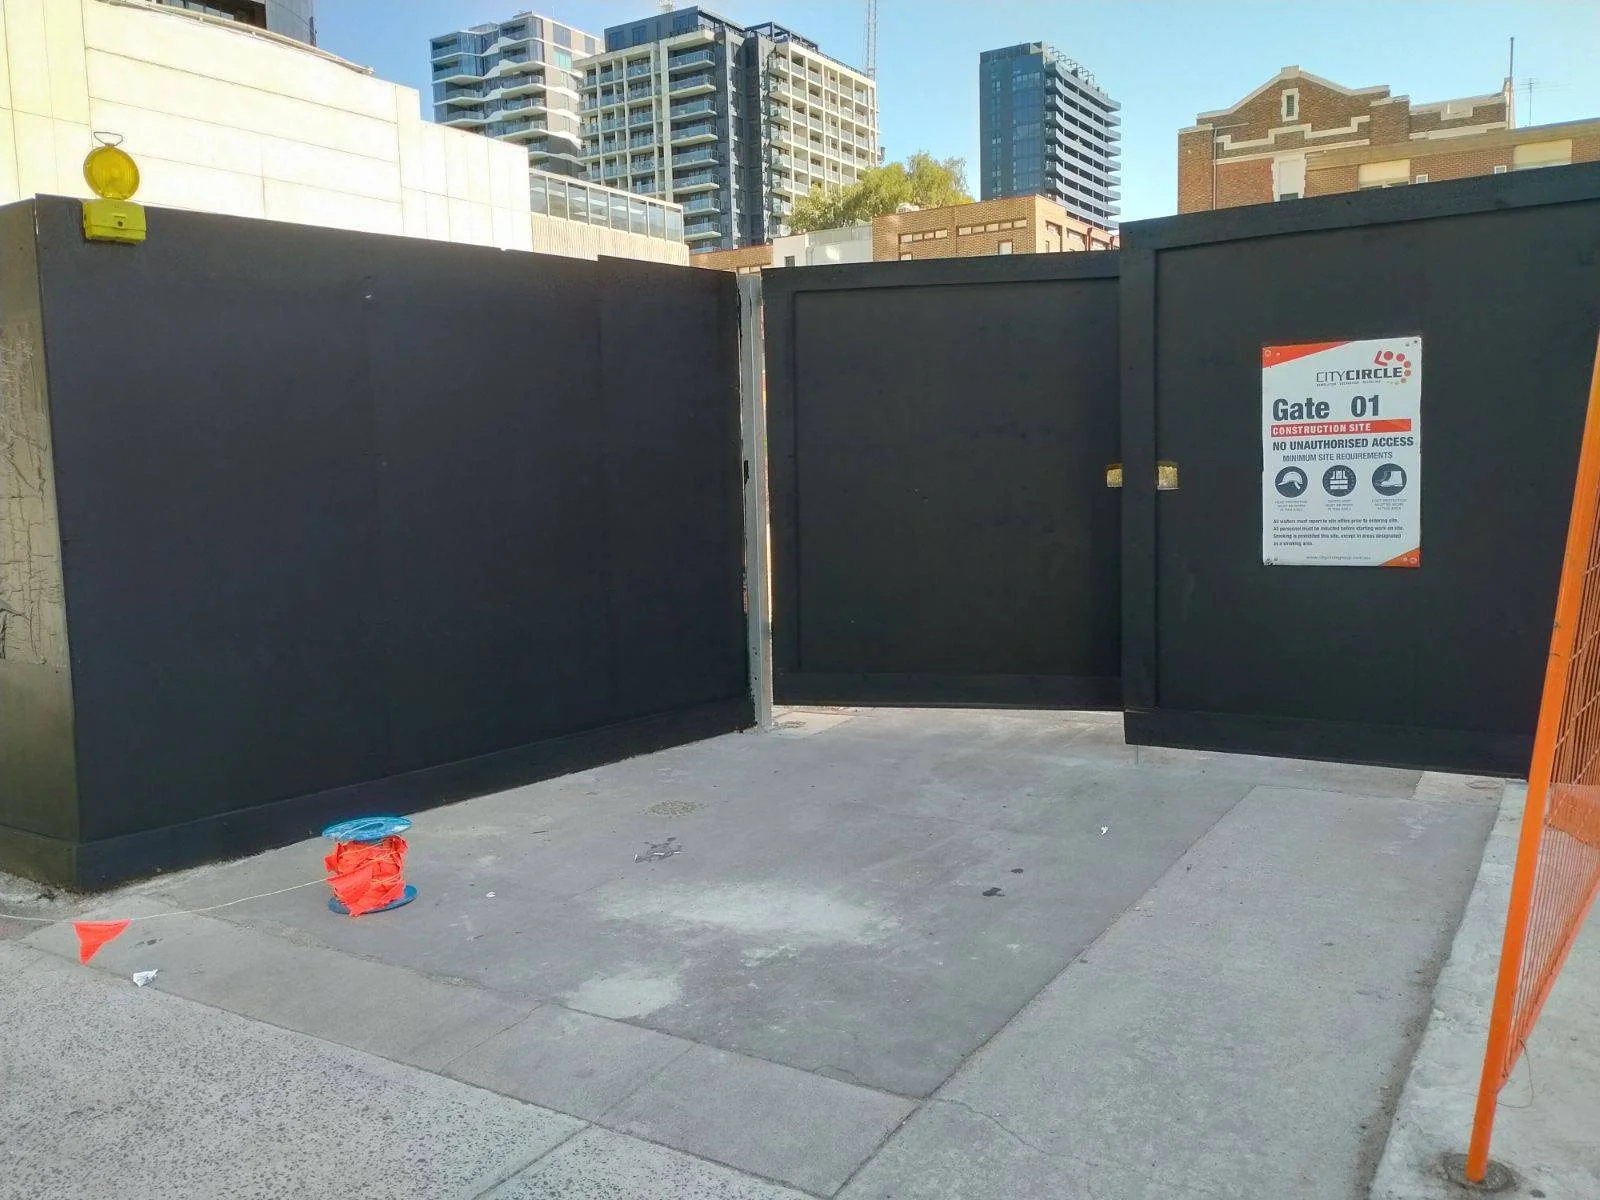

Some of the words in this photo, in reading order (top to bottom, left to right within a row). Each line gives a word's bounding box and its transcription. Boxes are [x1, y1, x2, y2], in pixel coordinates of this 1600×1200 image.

[1317, 367, 1402, 383] CITYCIRCLE
[1273, 397, 1330, 421] Gate
[1351, 395, 1379, 417] 01
[1273, 425, 1346, 435] CONSTRUCTION
[1349, 423, 1371, 432] SITE
[1273, 441, 1286, 451] NO
[1290, 438, 1368, 449] UNAUTHORISED
[1372, 436, 1413, 447] ACCESS
[1283, 454, 1316, 462] MINIMUM
[1318, 453, 1334, 461] SITE
[1336, 452, 1393, 460] REQUIREMENTS
